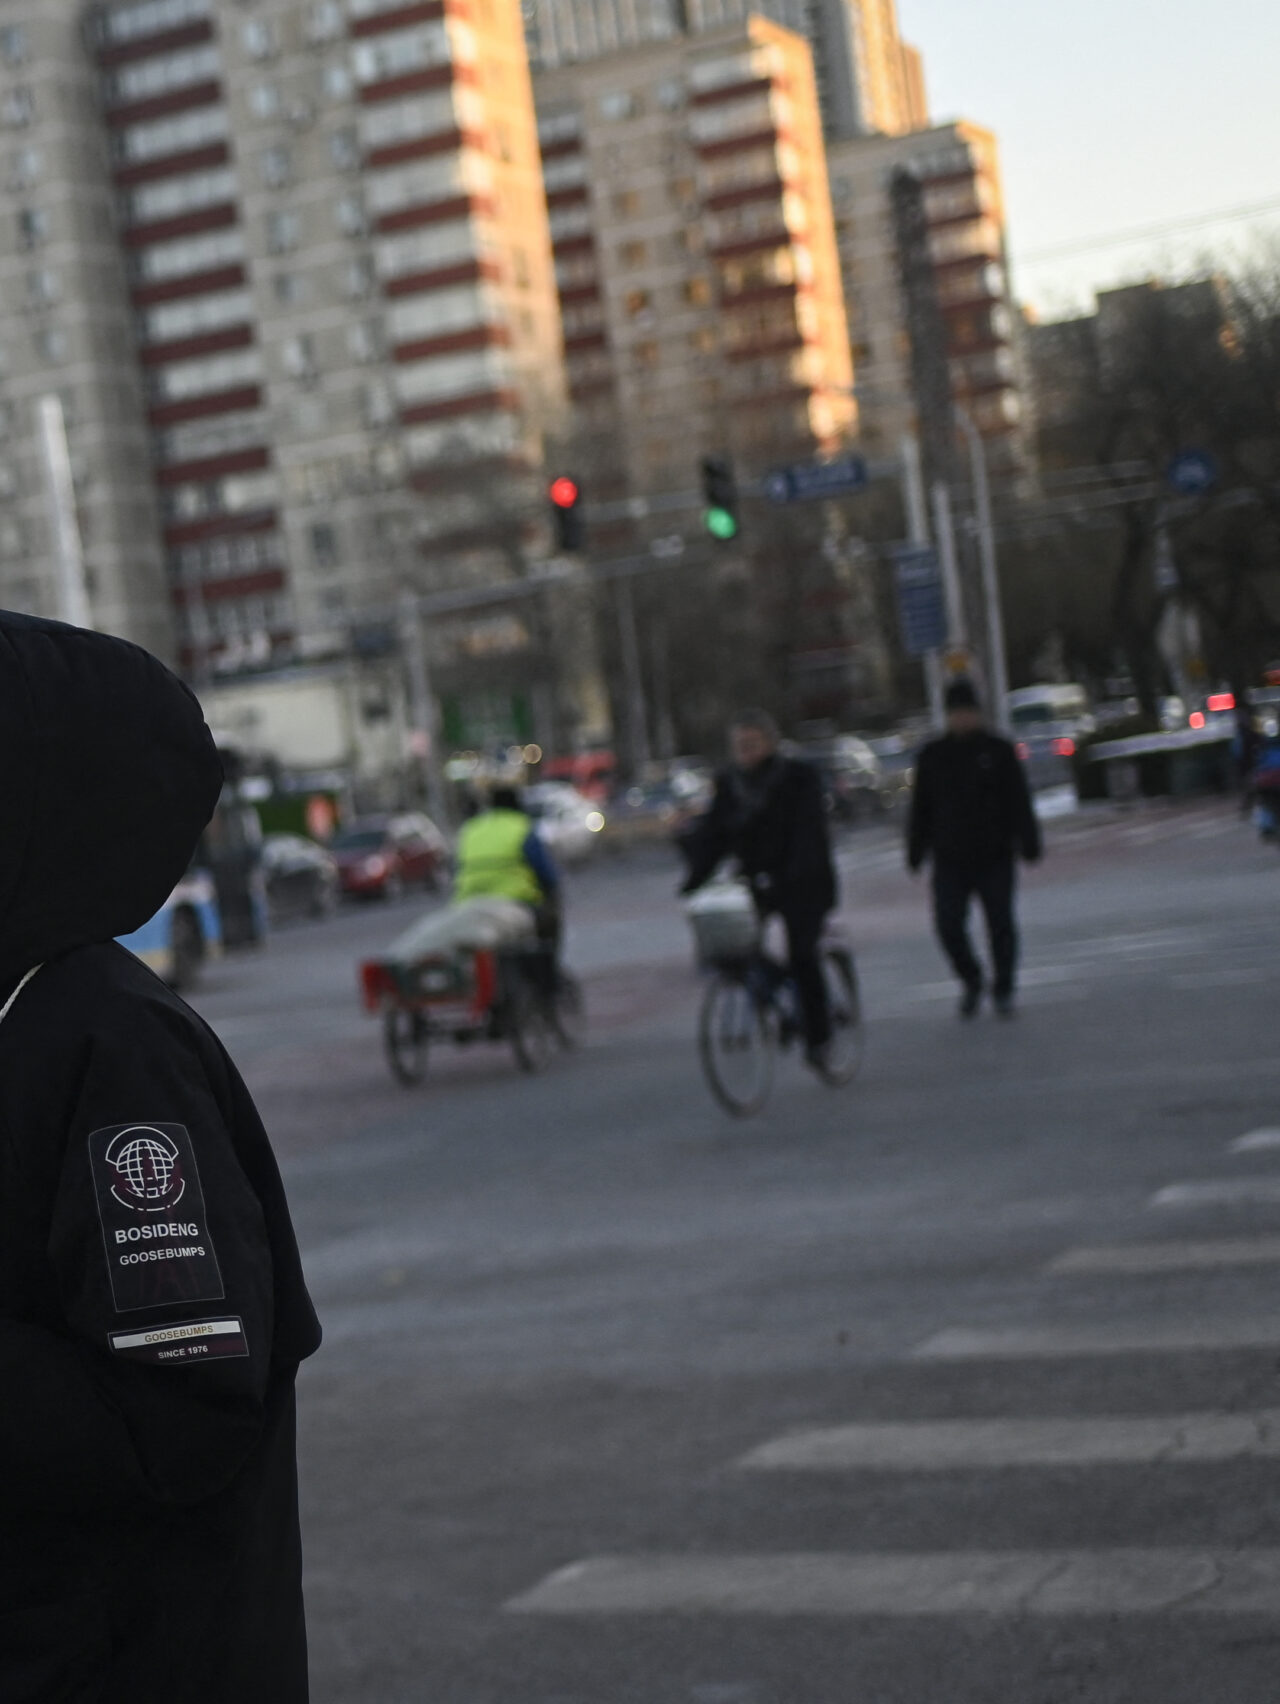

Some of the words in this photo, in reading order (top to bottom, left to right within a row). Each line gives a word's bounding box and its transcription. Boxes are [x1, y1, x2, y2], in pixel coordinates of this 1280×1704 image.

[115, 1223, 199, 1244] BOSIDENG
[120, 1246, 206, 1265] GOOSEBUMPS
[144, 1325, 214, 1343] GOOSEBUMPS
[158, 1348, 186, 1359] SINCE
[188, 1345, 208, 1355] 1976
